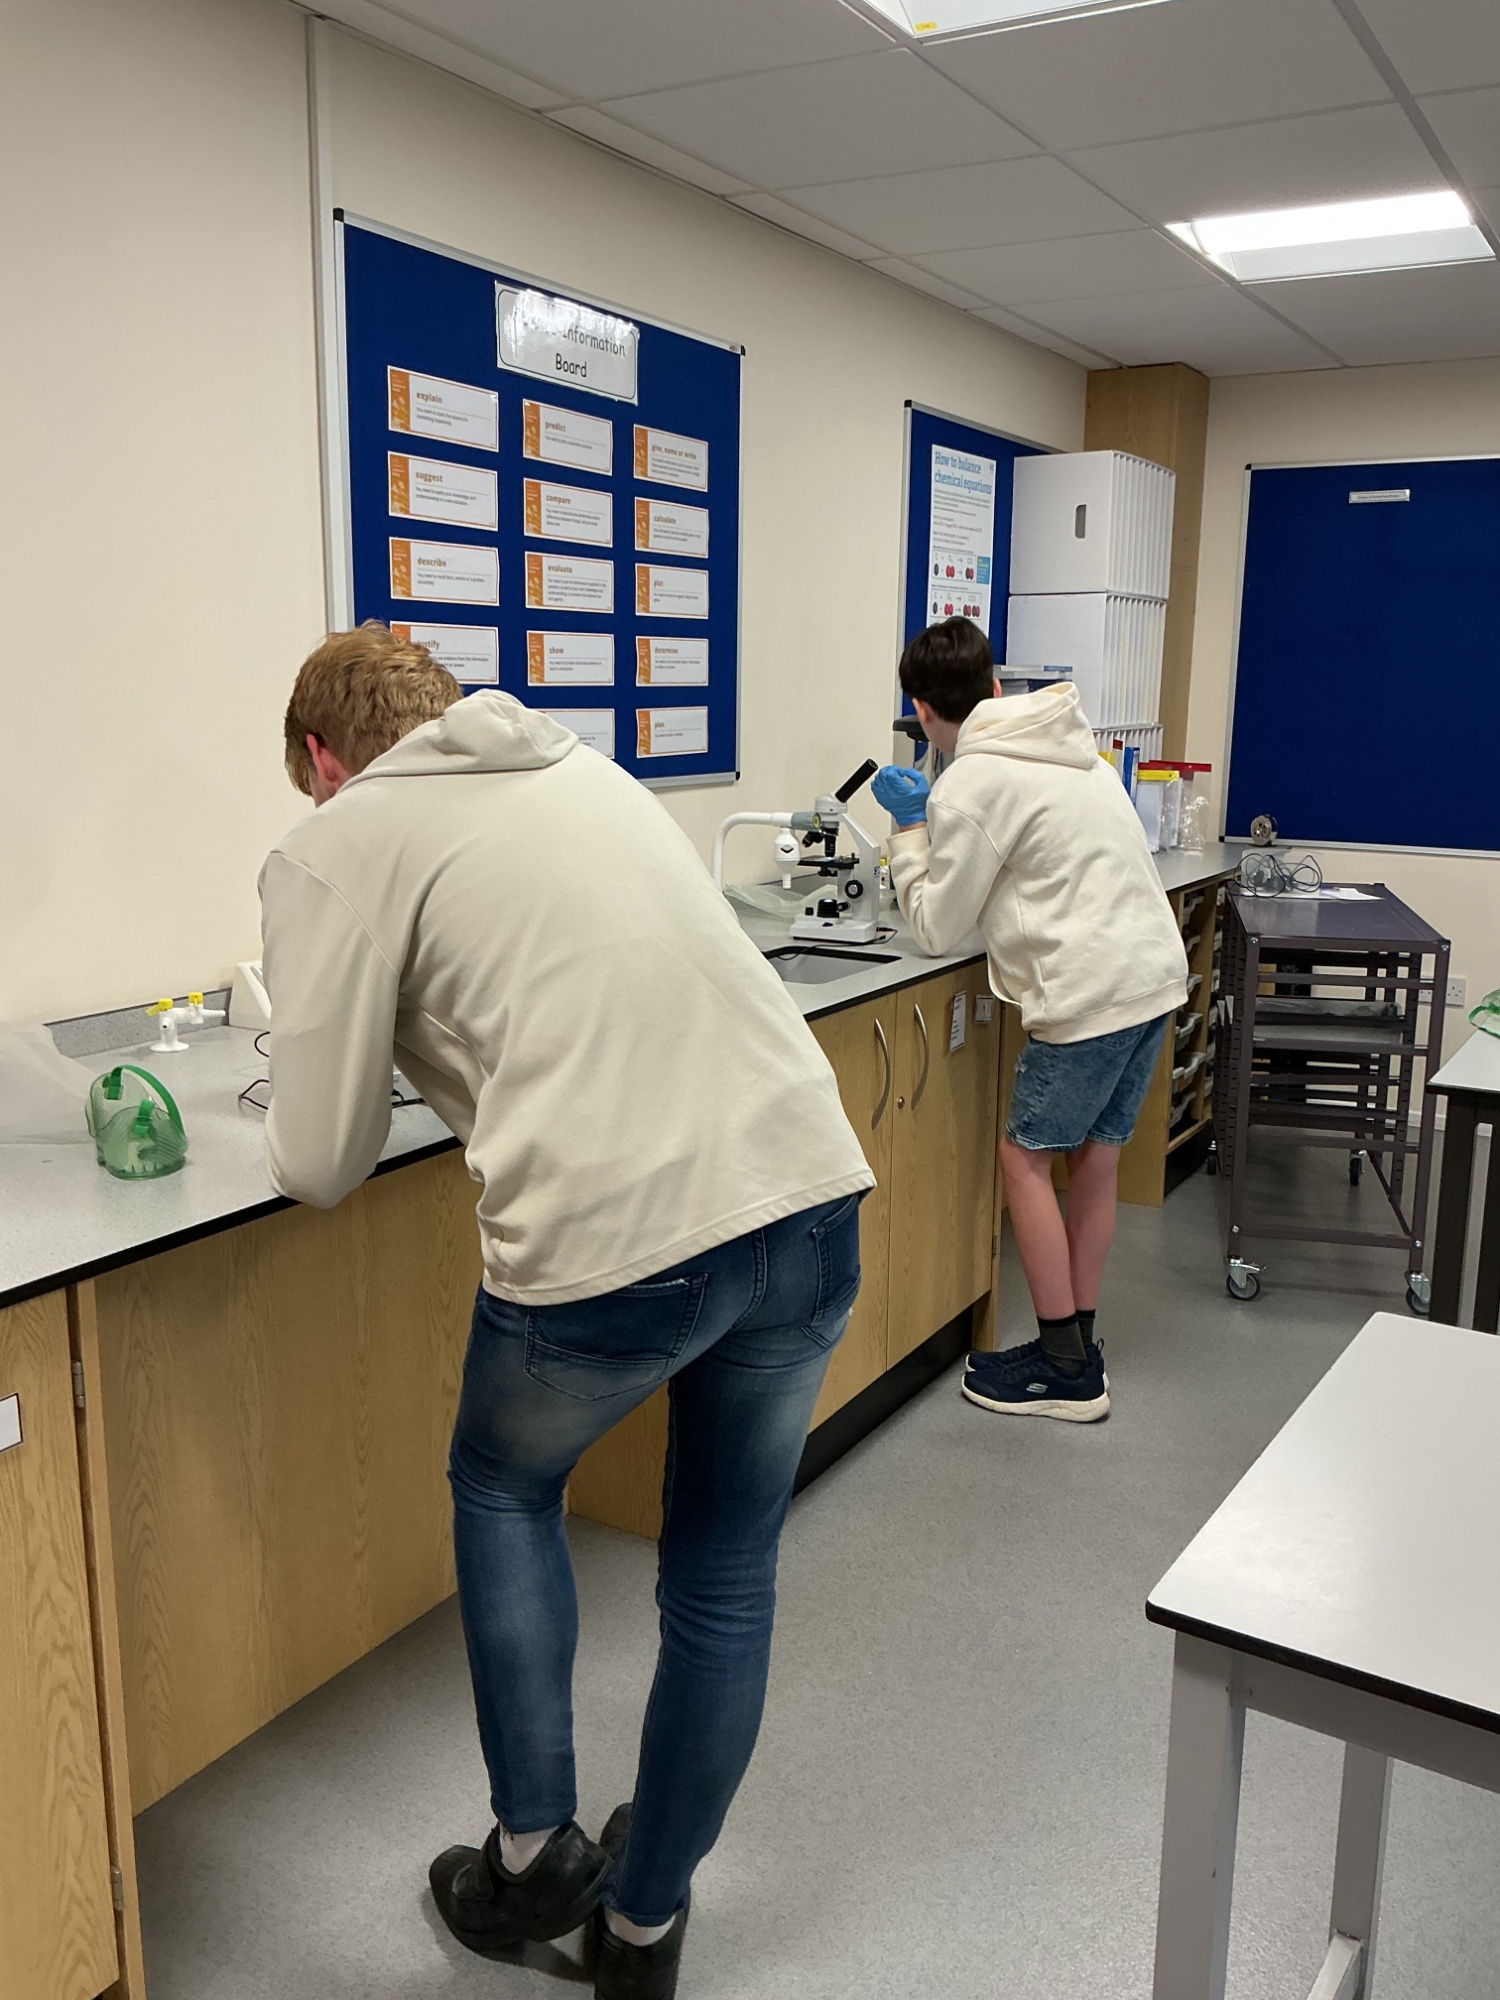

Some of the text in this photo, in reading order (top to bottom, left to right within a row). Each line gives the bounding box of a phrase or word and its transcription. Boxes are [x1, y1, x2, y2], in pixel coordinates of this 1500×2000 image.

[555, 353, 587, 377] Board
[416, 391, 443, 404] explain
[545, 422, 566, 433] predict
[934, 451, 949, 467] How
[950, 455, 957, 468] to
[957, 456, 982, 474] balance
[415, 471, 443, 482] suggest
[934, 469, 992, 494] chemical equations
[546, 494, 571, 505] compare
[654, 514, 676, 524] calculate
[417, 557, 447, 567] describe
[547, 564, 573, 574] evaluate
[653, 579, 664, 588] plot
[549, 646, 564, 655] show
[655, 646, 678, 655] determine
[654, 720, 665, 730] plan
